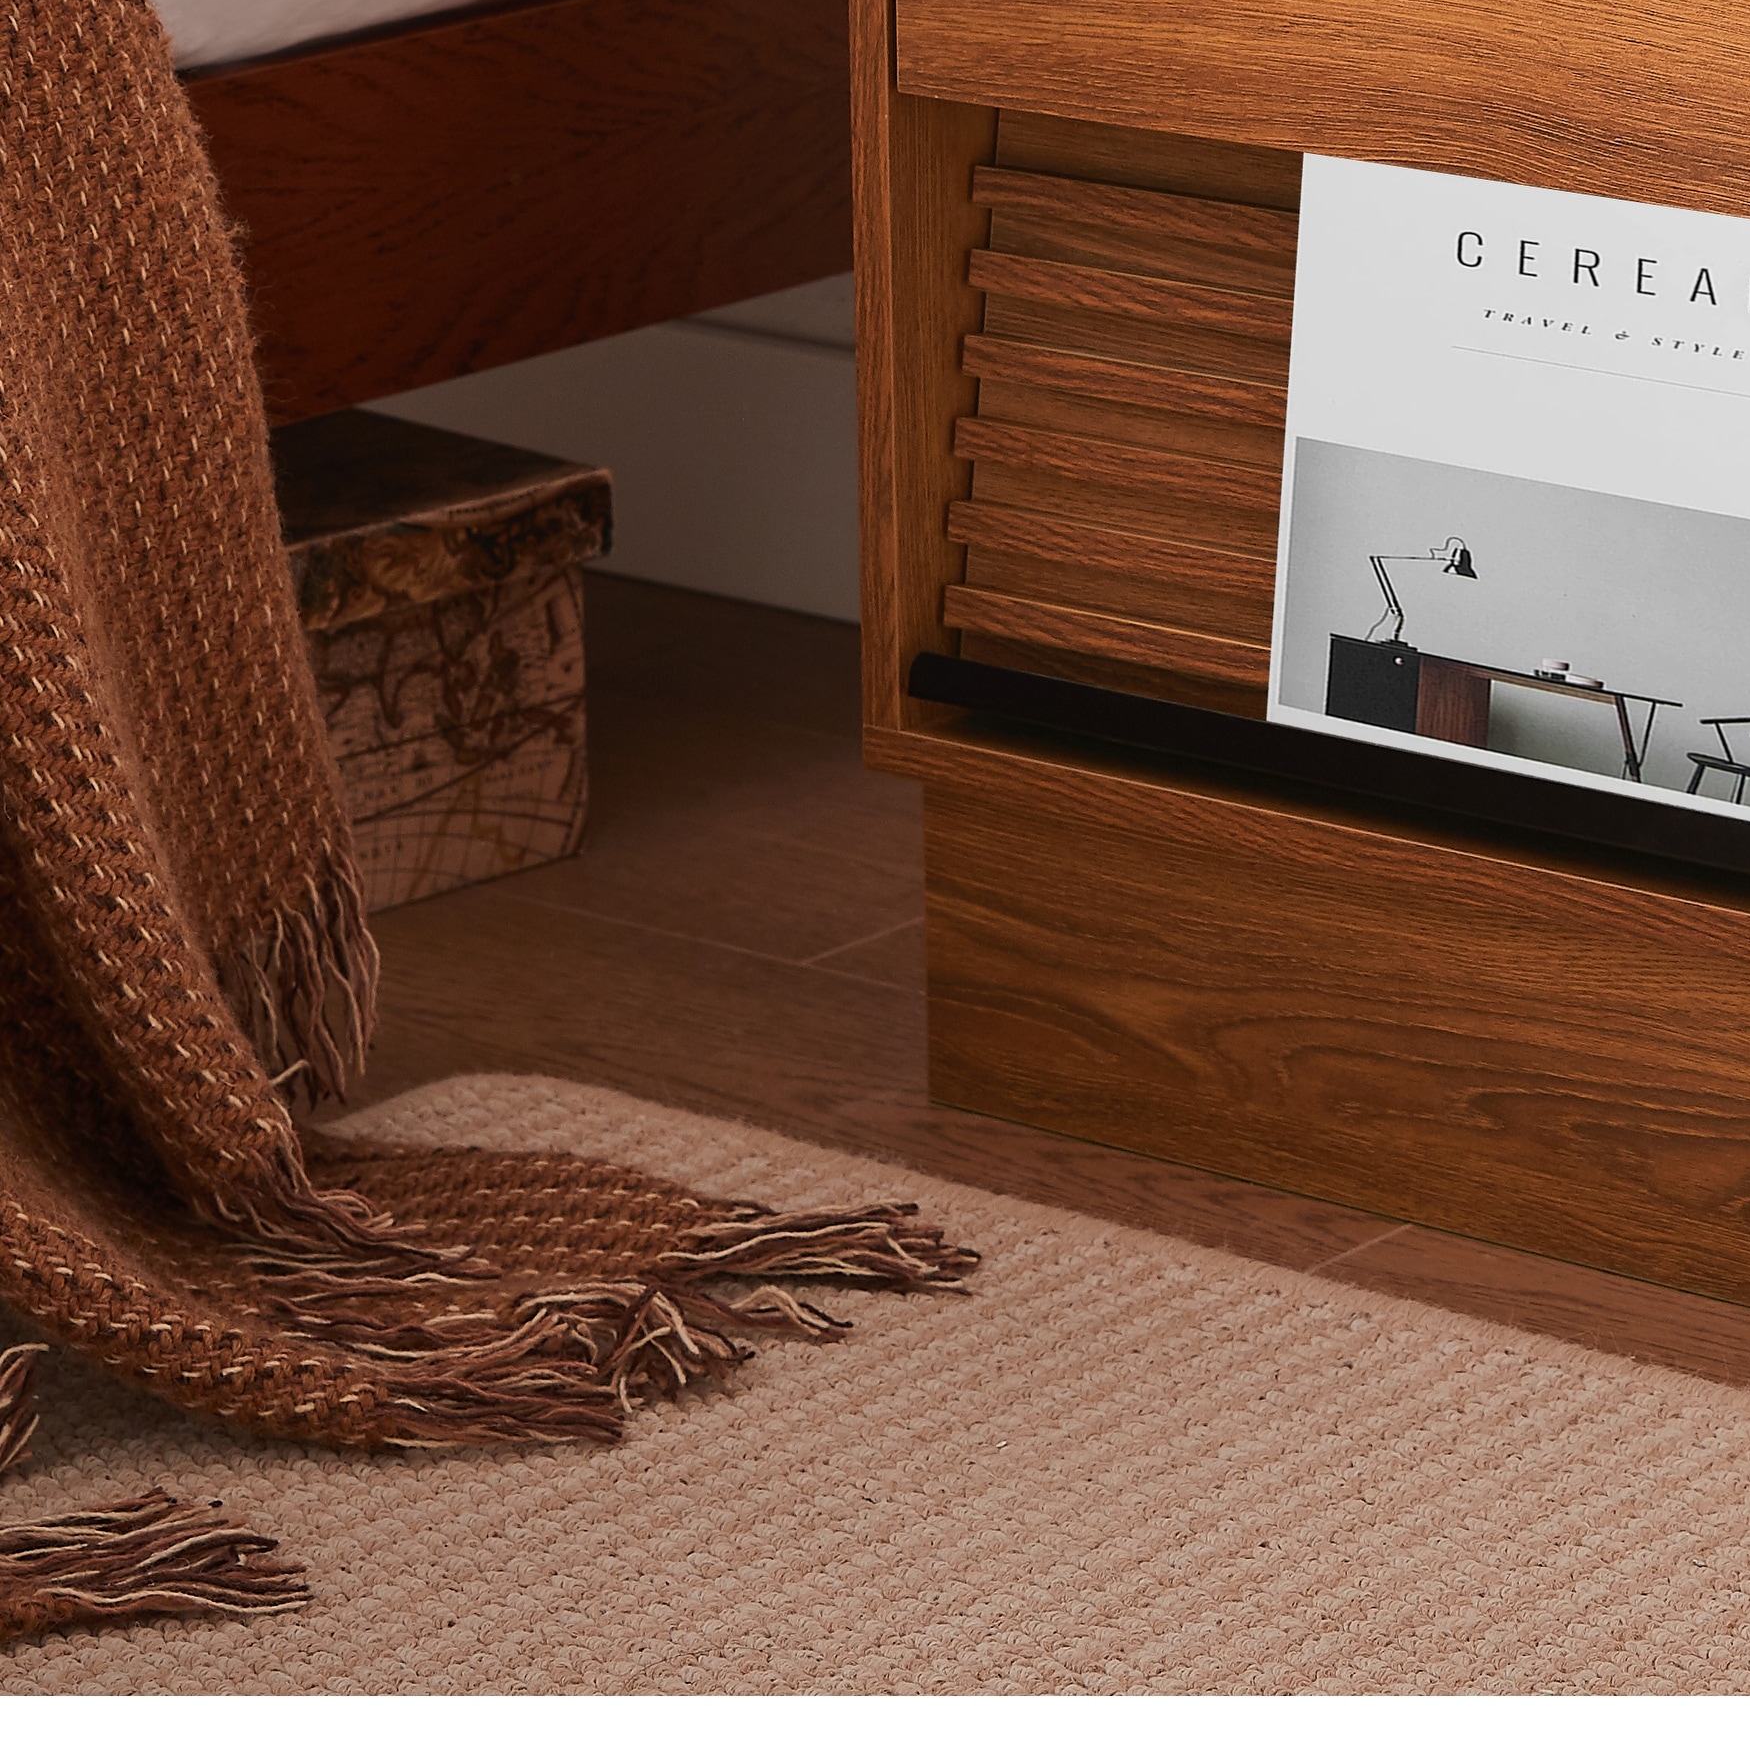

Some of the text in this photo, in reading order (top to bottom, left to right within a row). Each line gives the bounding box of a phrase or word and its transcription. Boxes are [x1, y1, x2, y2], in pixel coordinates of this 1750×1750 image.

[1482, 309, 1747, 360] TRAVEL & STYLE
